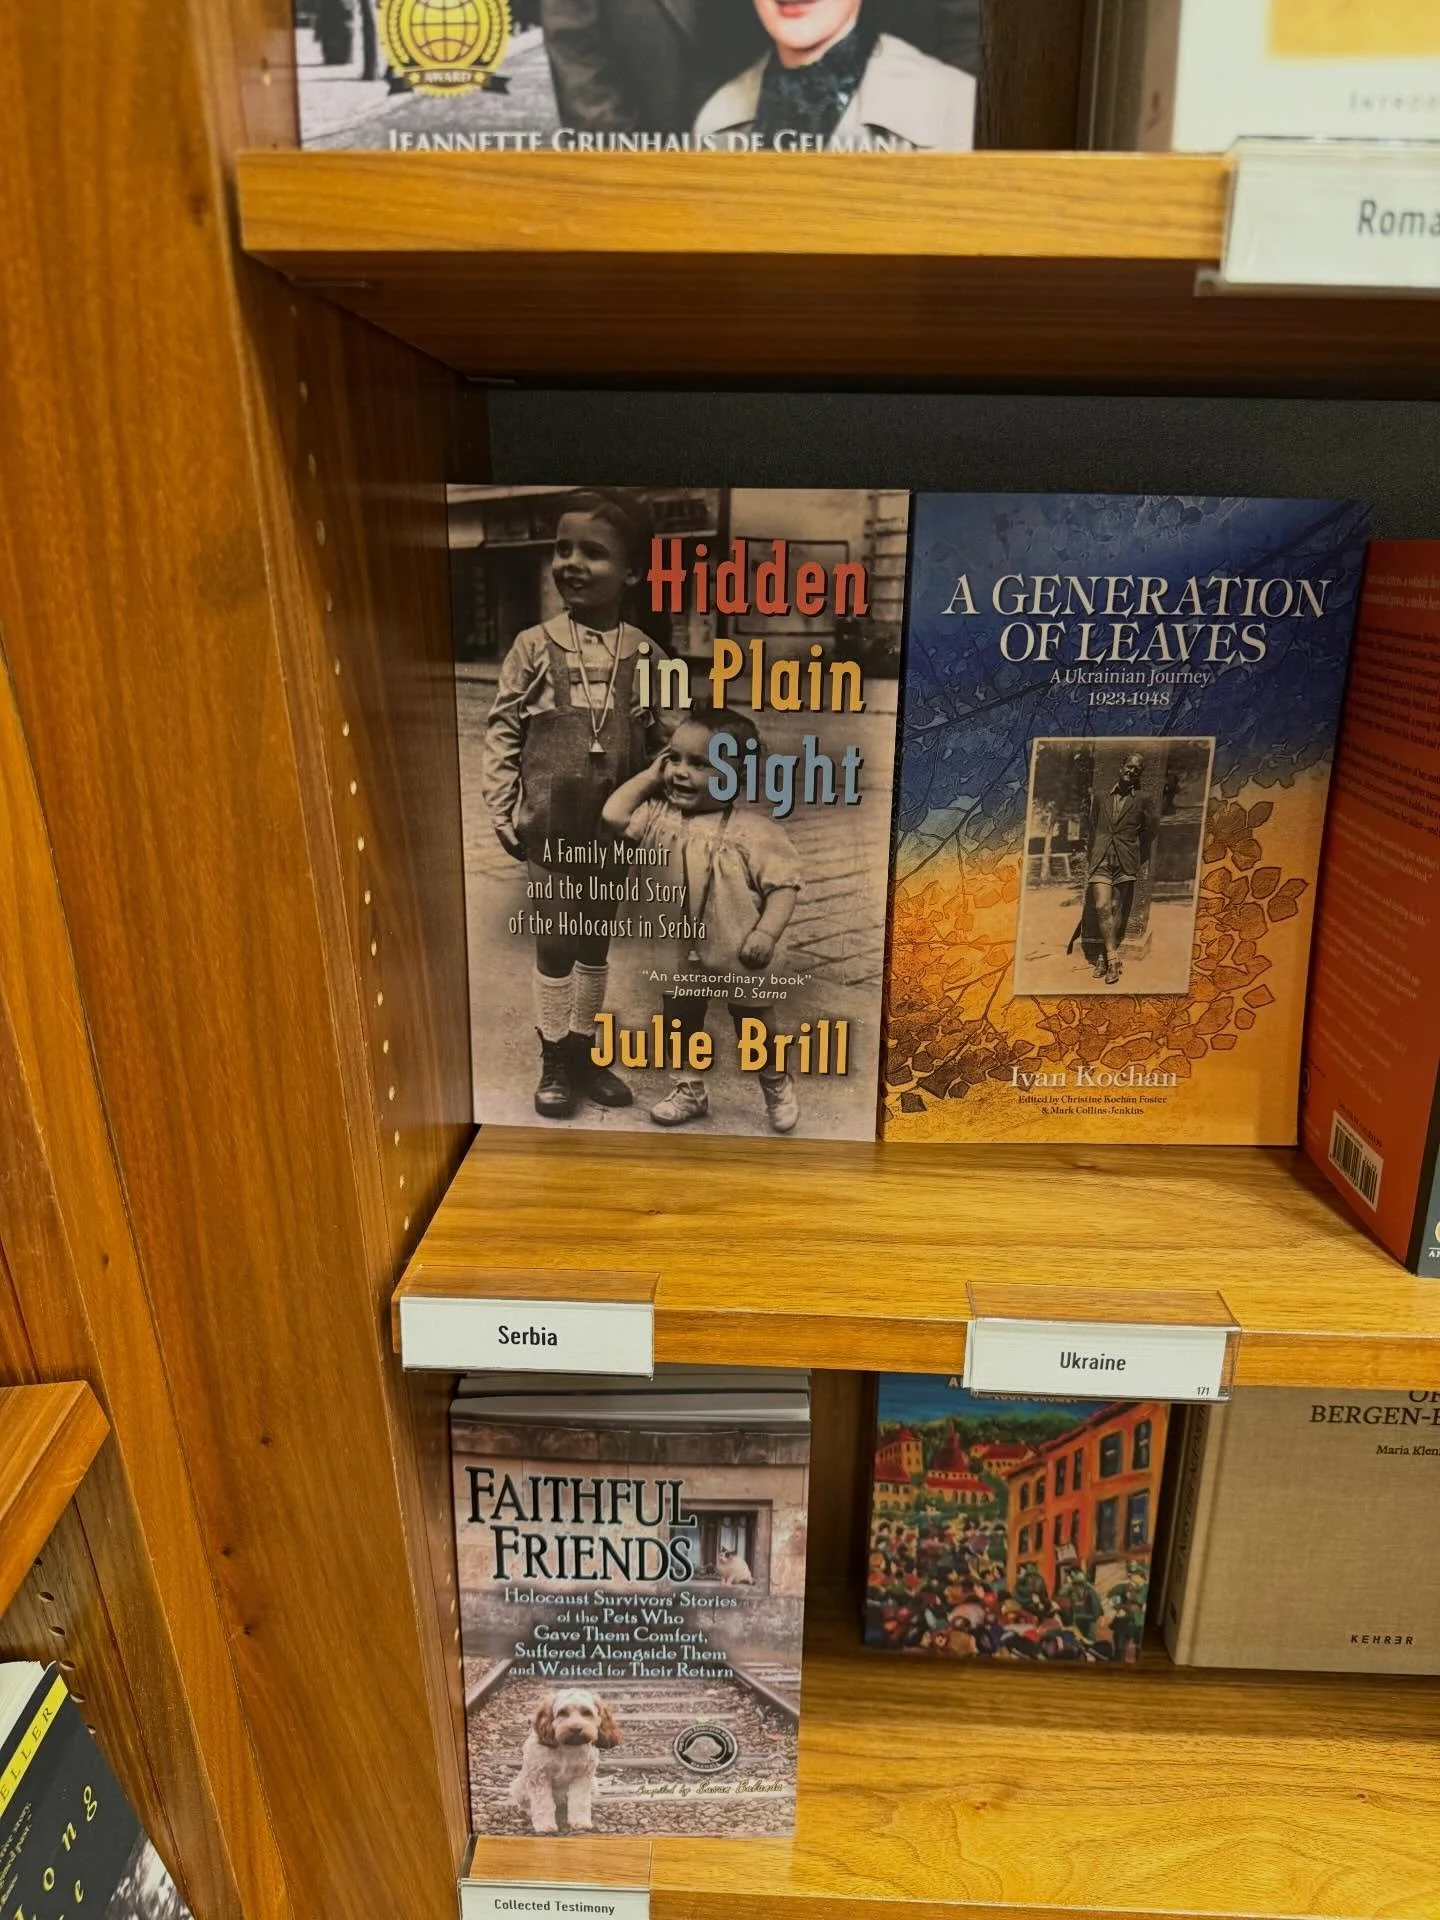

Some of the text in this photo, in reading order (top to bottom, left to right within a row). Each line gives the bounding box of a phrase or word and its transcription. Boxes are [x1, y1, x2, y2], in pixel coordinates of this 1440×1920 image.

[423, 70, 473, 83] AWARD
[647, 535, 869, 617] Hidden
[941, 573, 981, 616] A
[992, 573, 1333, 619] GENERATION
[1000, 622, 1267, 665] OF LEAVES
[636, 638, 865, 712] in Plain
[1050, 668, 1211, 688] A Ukrainian Journey
[1087, 690, 1171, 707] 1923-1948
[708, 732, 864, 818] Sight
[543, 839, 671, 869] A Family Memoir
[527, 876, 686, 907] and the Untold Story
[508, 911, 707, 940] of the Holocaust in Serbia
[673, 970, 765, 987] extraordinary
[734, 987, 747, 999] D.
[751, 988, 787, 1000] Sarna
[590, 1012, 850, 1076] Julie Brill
[1009, 1064, 1178, 1088] Ivan Kochan
[1018, 1095, 1167, 1105] Edited by Christine Kochan Foster
[1041, 1106, 1145, 1115] & Mark Collins Jenkins
[498, 1325, 558, 1346] Serbia
[1059, 1351, 1127, 1372] Ukraine
[1196, 1386, 1210, 1396] 171
[1376, 1444, 1410, 1455] Maria
[464, 1464, 698, 1528] FAITHFUL
[490, 1524, 694, 1583] FRIENDS
[504, 1587, 589, 1606] Holocaust
[679, 1591, 738, 1609] Stories
[556, 1609, 684, 1625] of the Pets Who
[534, 1625, 708, 1645] Gave Them Comfort,
[515, 1642, 727, 1663] Suffered Alongside Them
[509, 1662, 734, 1678] and Waited for Their Return
[494, 1898, 616, 1915] Collected Testimony
